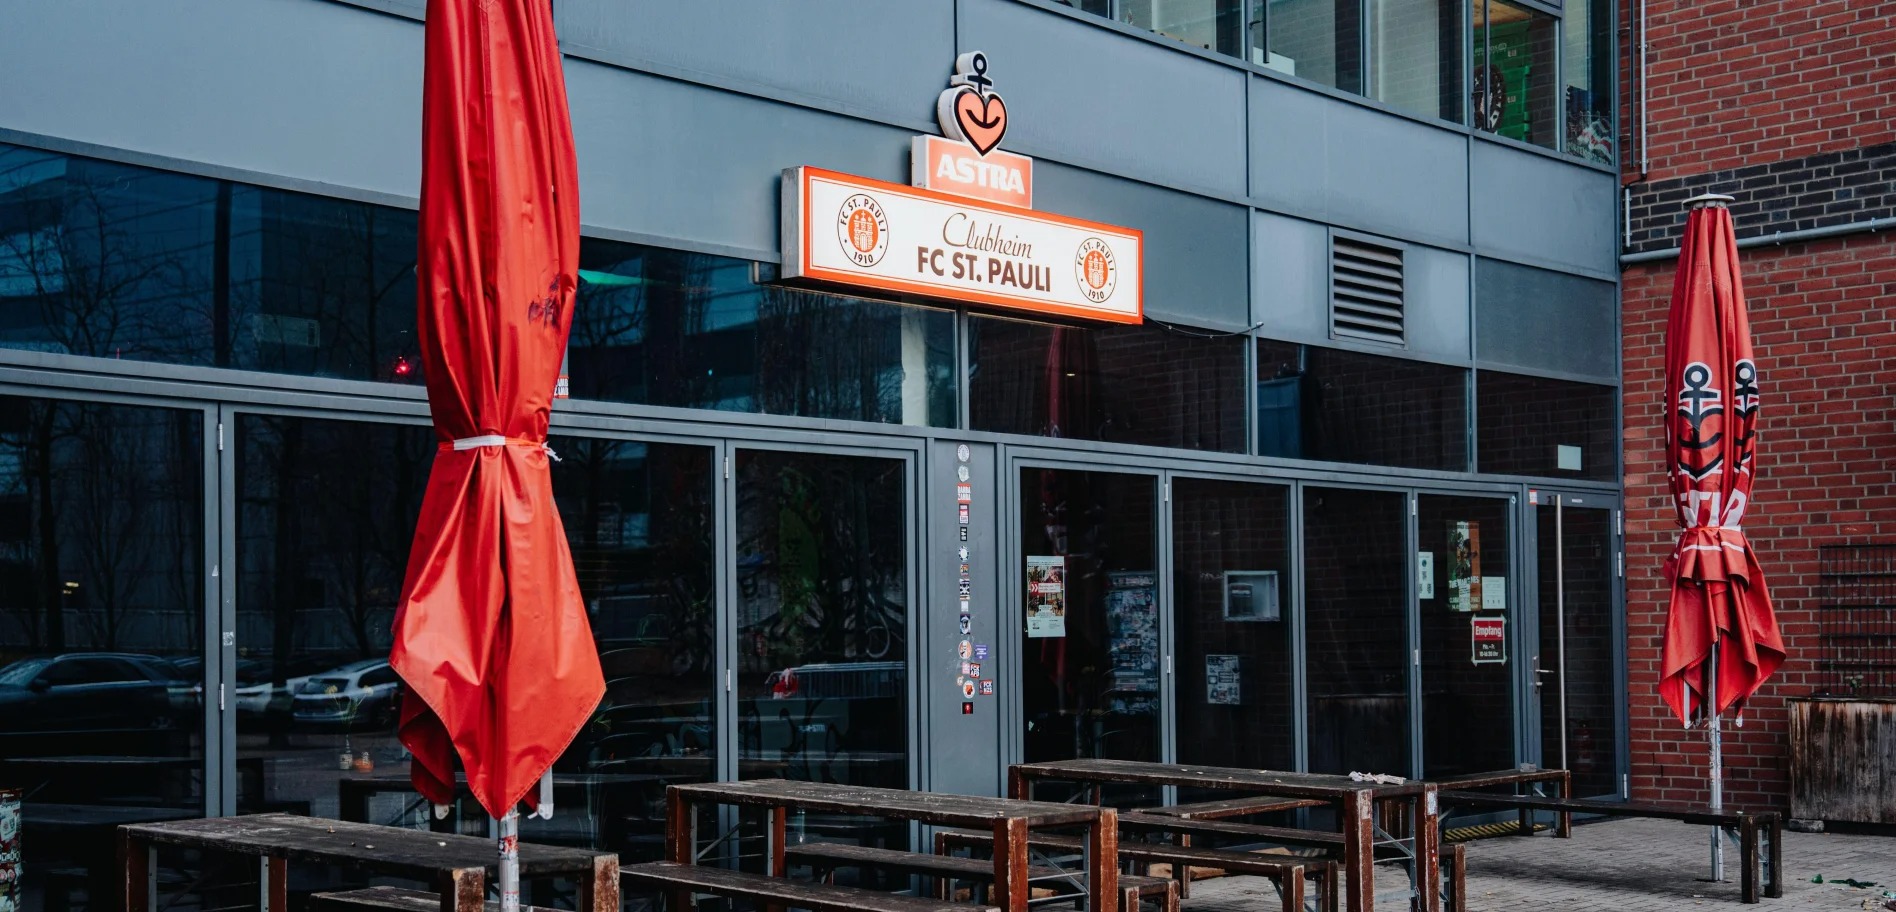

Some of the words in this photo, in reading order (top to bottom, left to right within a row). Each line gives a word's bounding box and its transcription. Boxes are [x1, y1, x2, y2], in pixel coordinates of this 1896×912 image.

[937, 154, 1025, 194] ASTRA
[841, 211, 848, 225] FC
[848, 199, 860, 211] ST.
[864, 199, 886, 231] PAULI
[943, 212, 1032, 258] Clubheim
[853, 252, 873, 263] 1910
[917, 246, 944, 276] FC
[952, 252, 982, 282] ST.
[988, 257, 1050, 292] PAULI
[1077, 254, 1084, 266] FC
[1084, 242, 1093, 253] ST.
[1097, 242, 1114, 271] PAULI
[1088, 289, 1105, 300] 1910
[1475, 626, 1501, 637] Empfang
